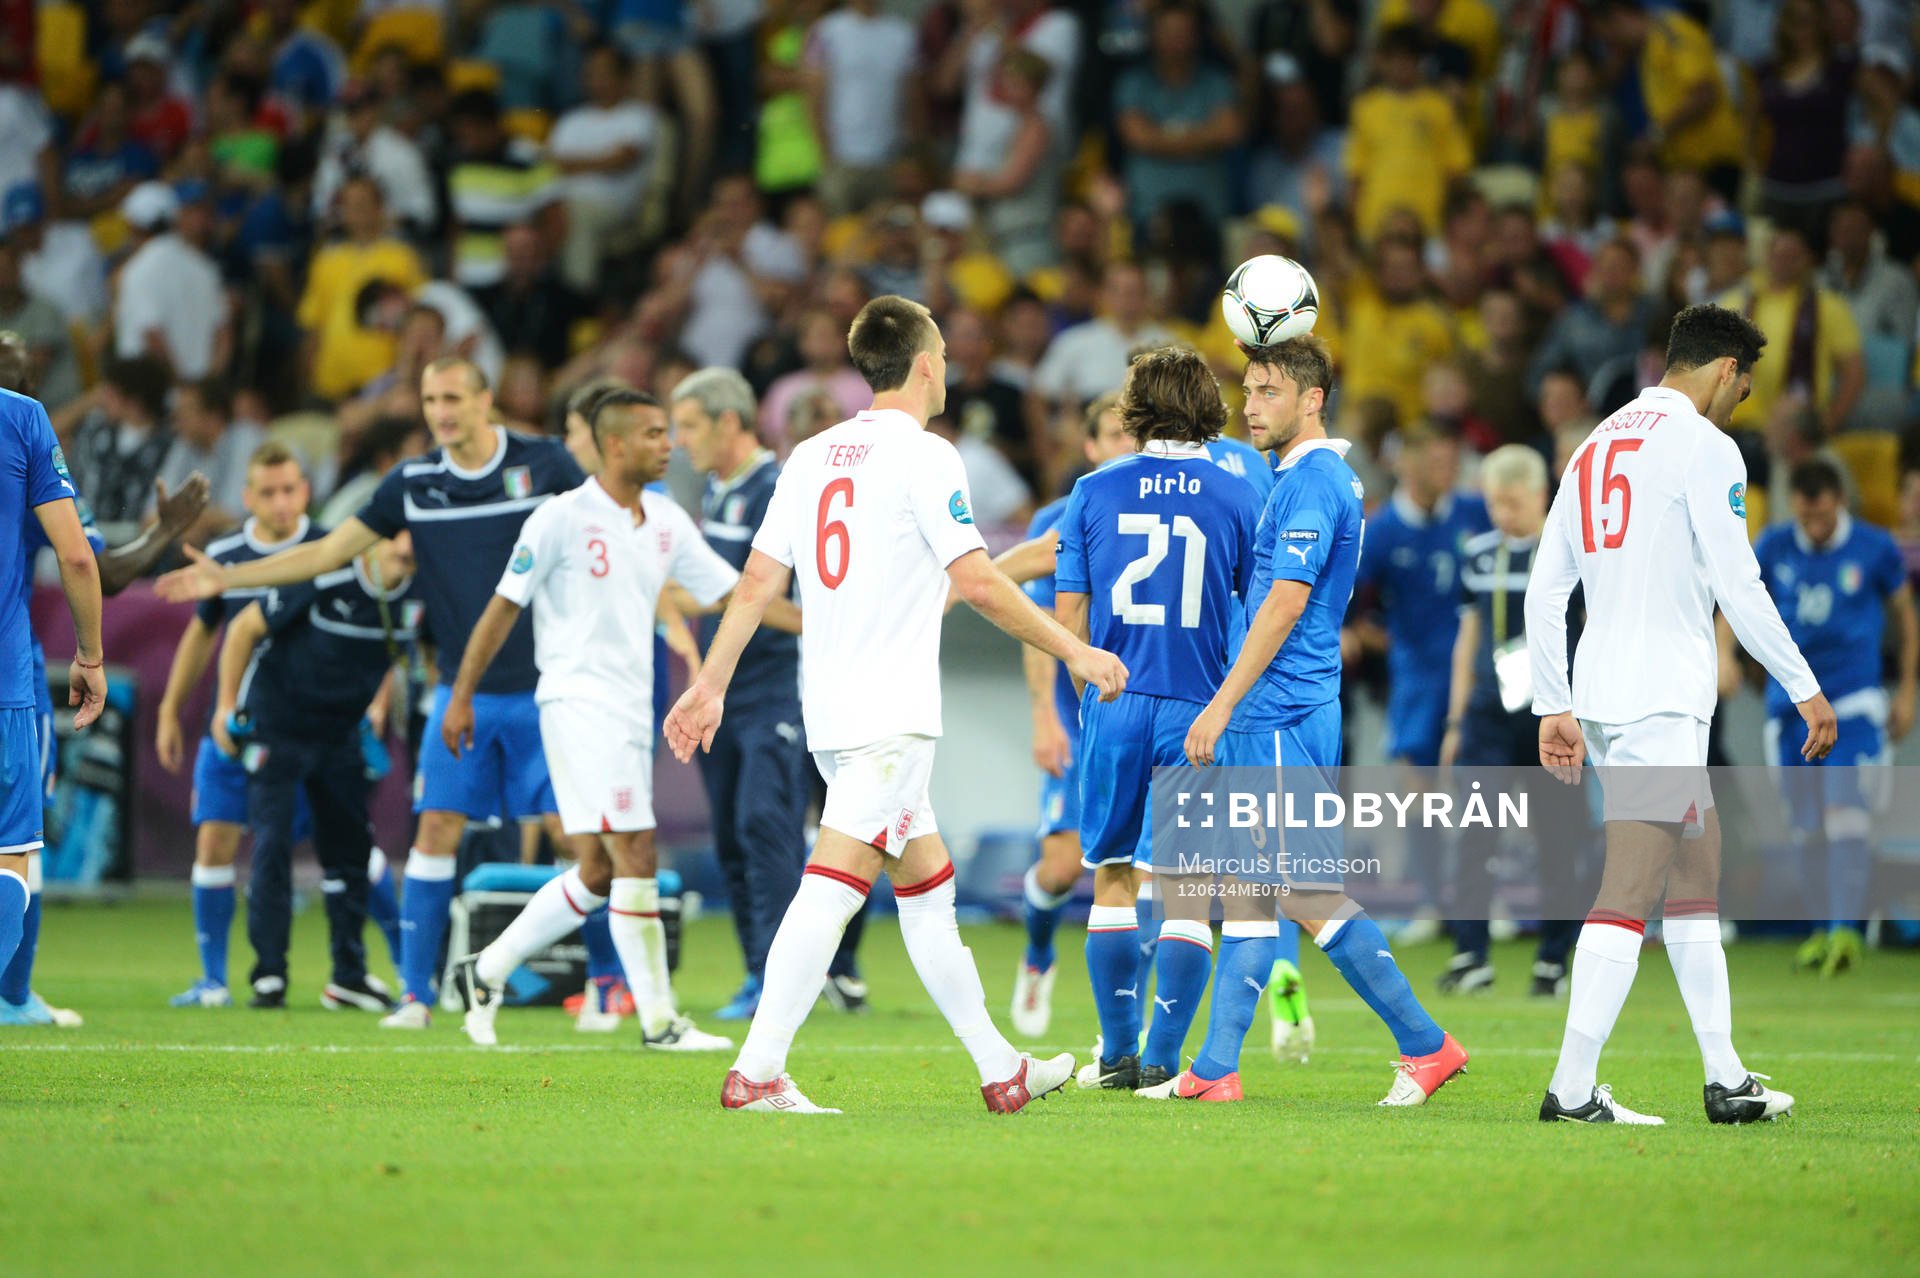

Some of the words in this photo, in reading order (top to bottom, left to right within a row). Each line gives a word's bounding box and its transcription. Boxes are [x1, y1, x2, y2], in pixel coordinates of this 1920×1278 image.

[824, 443, 874, 467] TERRY
[1139, 472, 1201, 498] pirlo
[1572, 438, 1644, 553] 15
[816, 477, 854, 590] 6
[1288, 531, 1318, 539] RESPECT
[587, 539, 610, 578] 3
[1111, 513, 1207, 629] 21
